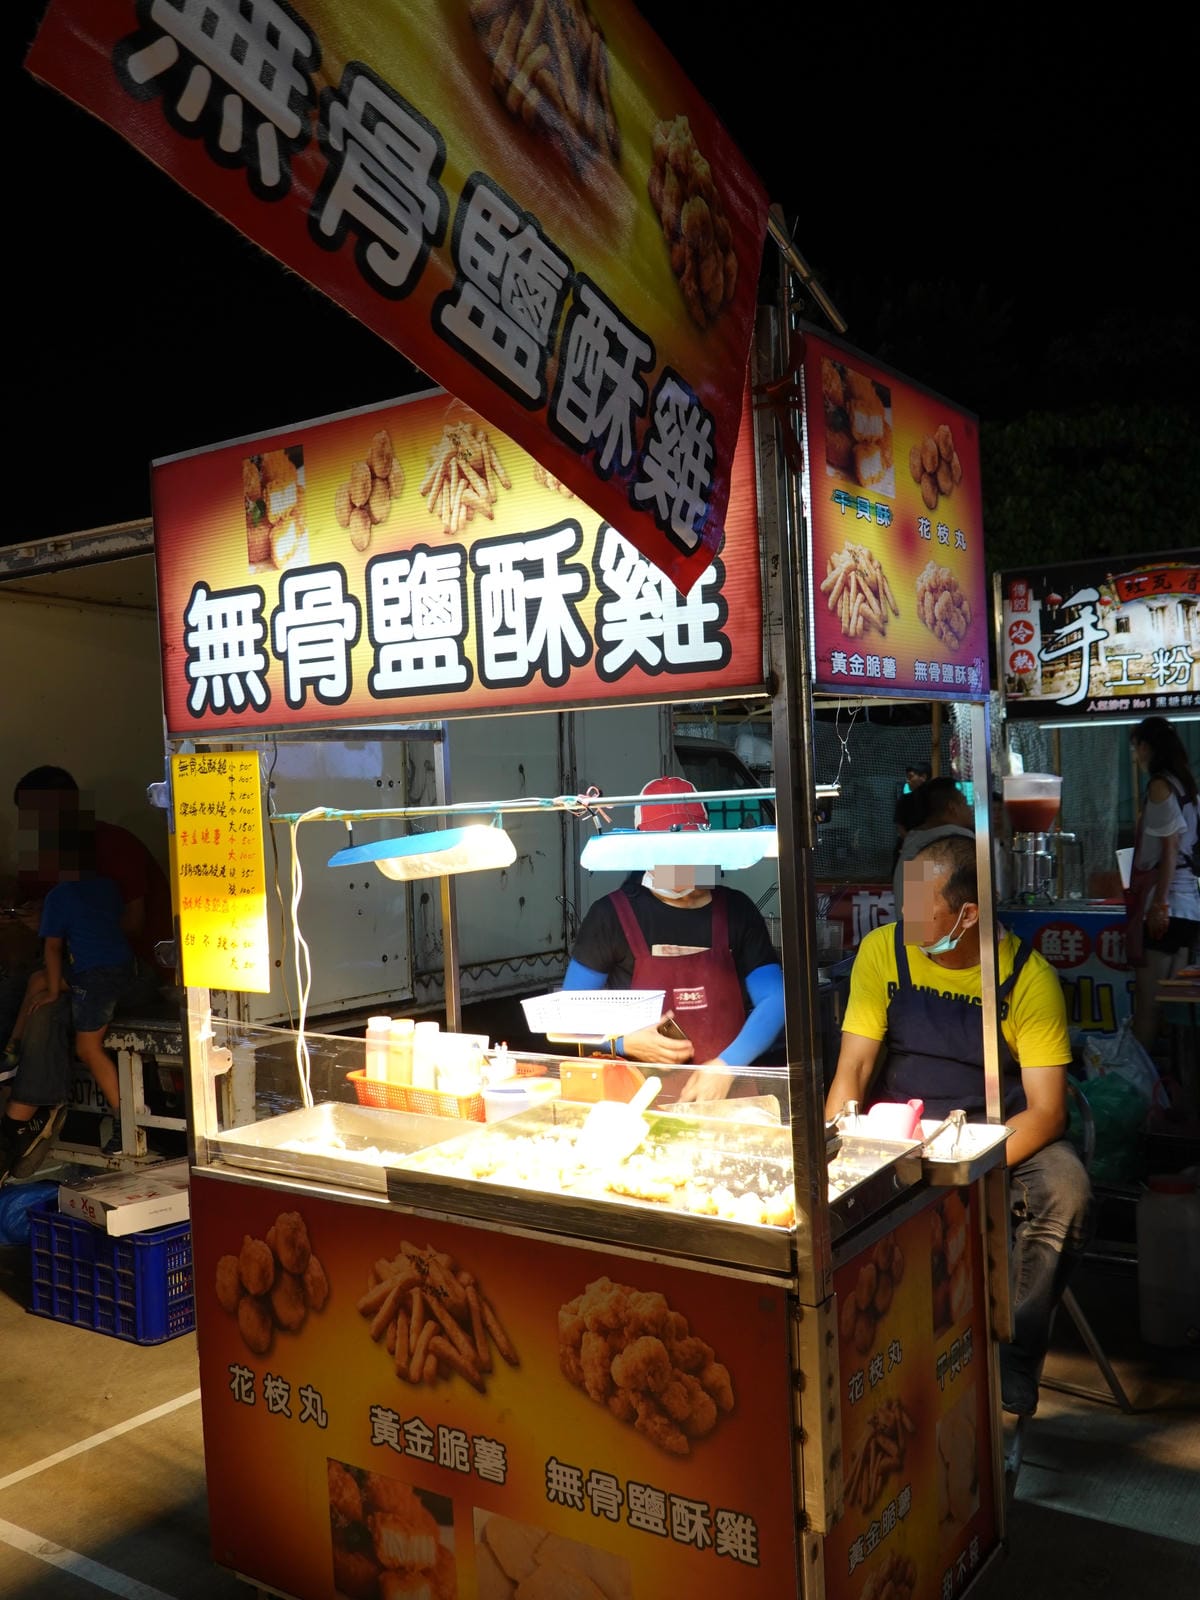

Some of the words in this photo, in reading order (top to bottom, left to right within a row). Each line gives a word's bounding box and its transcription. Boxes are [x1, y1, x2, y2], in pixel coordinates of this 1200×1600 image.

[115, 0, 720, 553] 無骨鹽酥雞
[917, 516, 968, 551] 花枝丸
[185, 518, 730, 716] 無骨鹽酥雞
[1010, 621, 1034, 643] 冷
[830, 650, 897, 681] 黃金脆薯
[1040, 929, 1085, 963] 鮮
[228, 1362, 329, 1430] 花枝丸
[847, 1339, 904, 1405] 花枝丸
[370, 1405, 508, 1486] 黃金脆薯
[545, 1457, 761, 1567] 無骨鹽酥雞
[847, 1485, 913, 1577] 黃金脆薯
